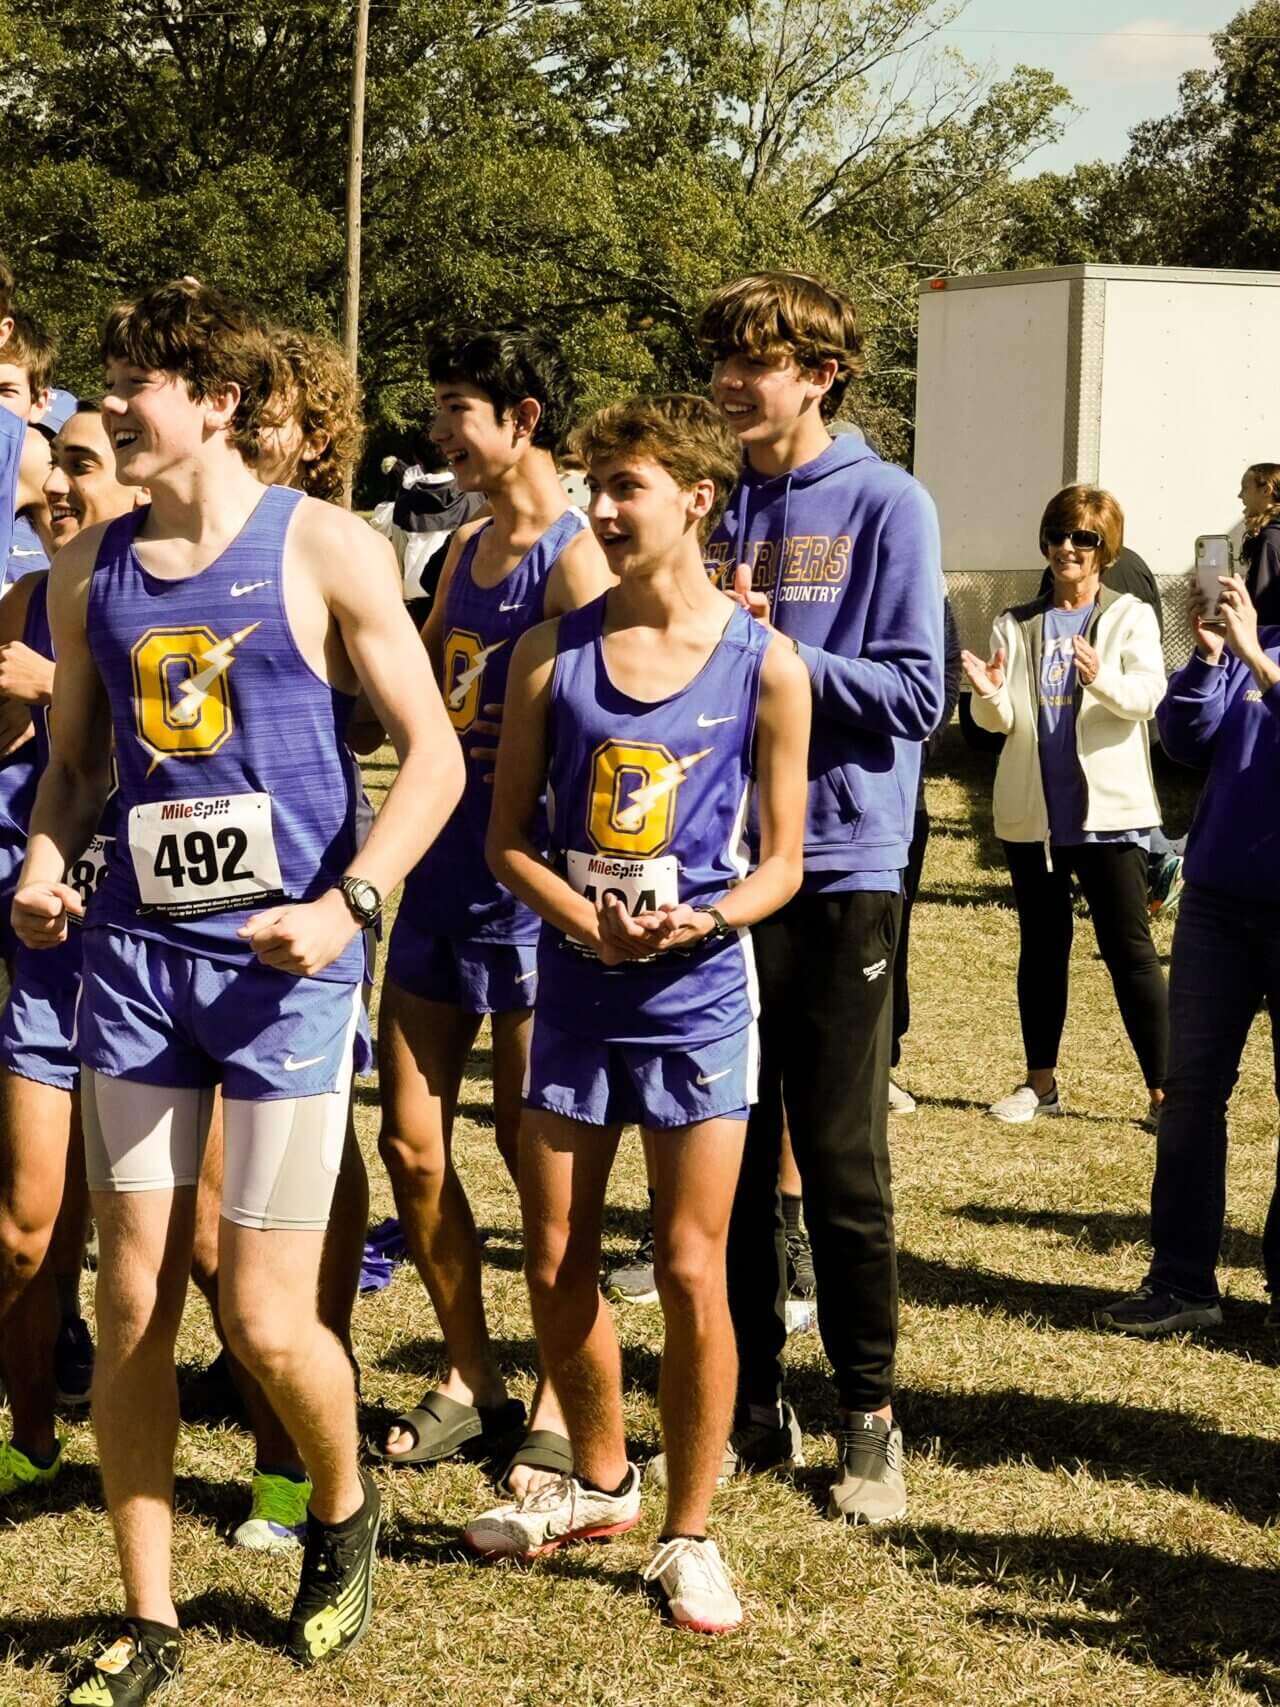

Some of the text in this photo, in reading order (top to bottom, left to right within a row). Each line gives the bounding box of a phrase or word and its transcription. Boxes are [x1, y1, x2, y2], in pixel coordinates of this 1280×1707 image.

[779, 586, 841, 603] COUNTRY
[130, 625, 233, 757] O
[444, 627, 483, 736] O
[161, 799, 231, 820] MileSplit
[586, 738, 678, 860] O
[154, 827, 255, 888] 492
[588, 859, 645, 880] MileSplit
